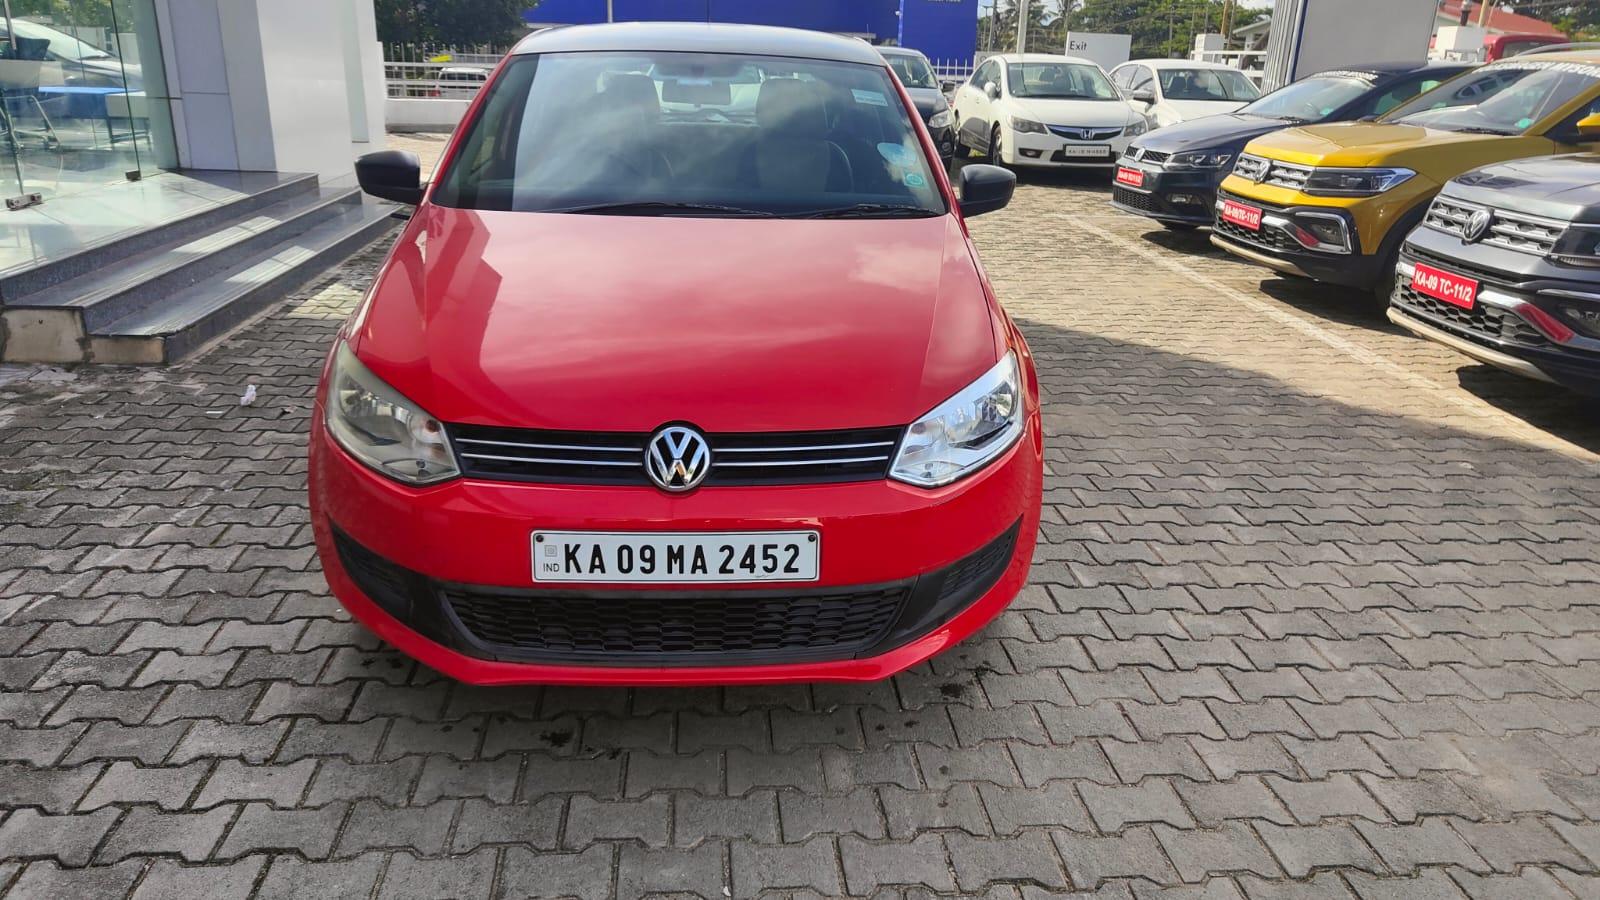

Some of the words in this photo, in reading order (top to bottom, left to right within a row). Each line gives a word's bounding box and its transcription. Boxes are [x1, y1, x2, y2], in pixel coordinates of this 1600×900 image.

[1070, 41, 1087, 50] Exit
[1415, 270, 1438, 290] KA-09
[1440, 278, 1473, 302] TC-11/2
[543, 563, 560, 573] IND
[564, 543, 606, 574] KA
[617, 544, 656, 575] 09
[667, 544, 708, 575] MA
[718, 543, 800, 574] 2452
